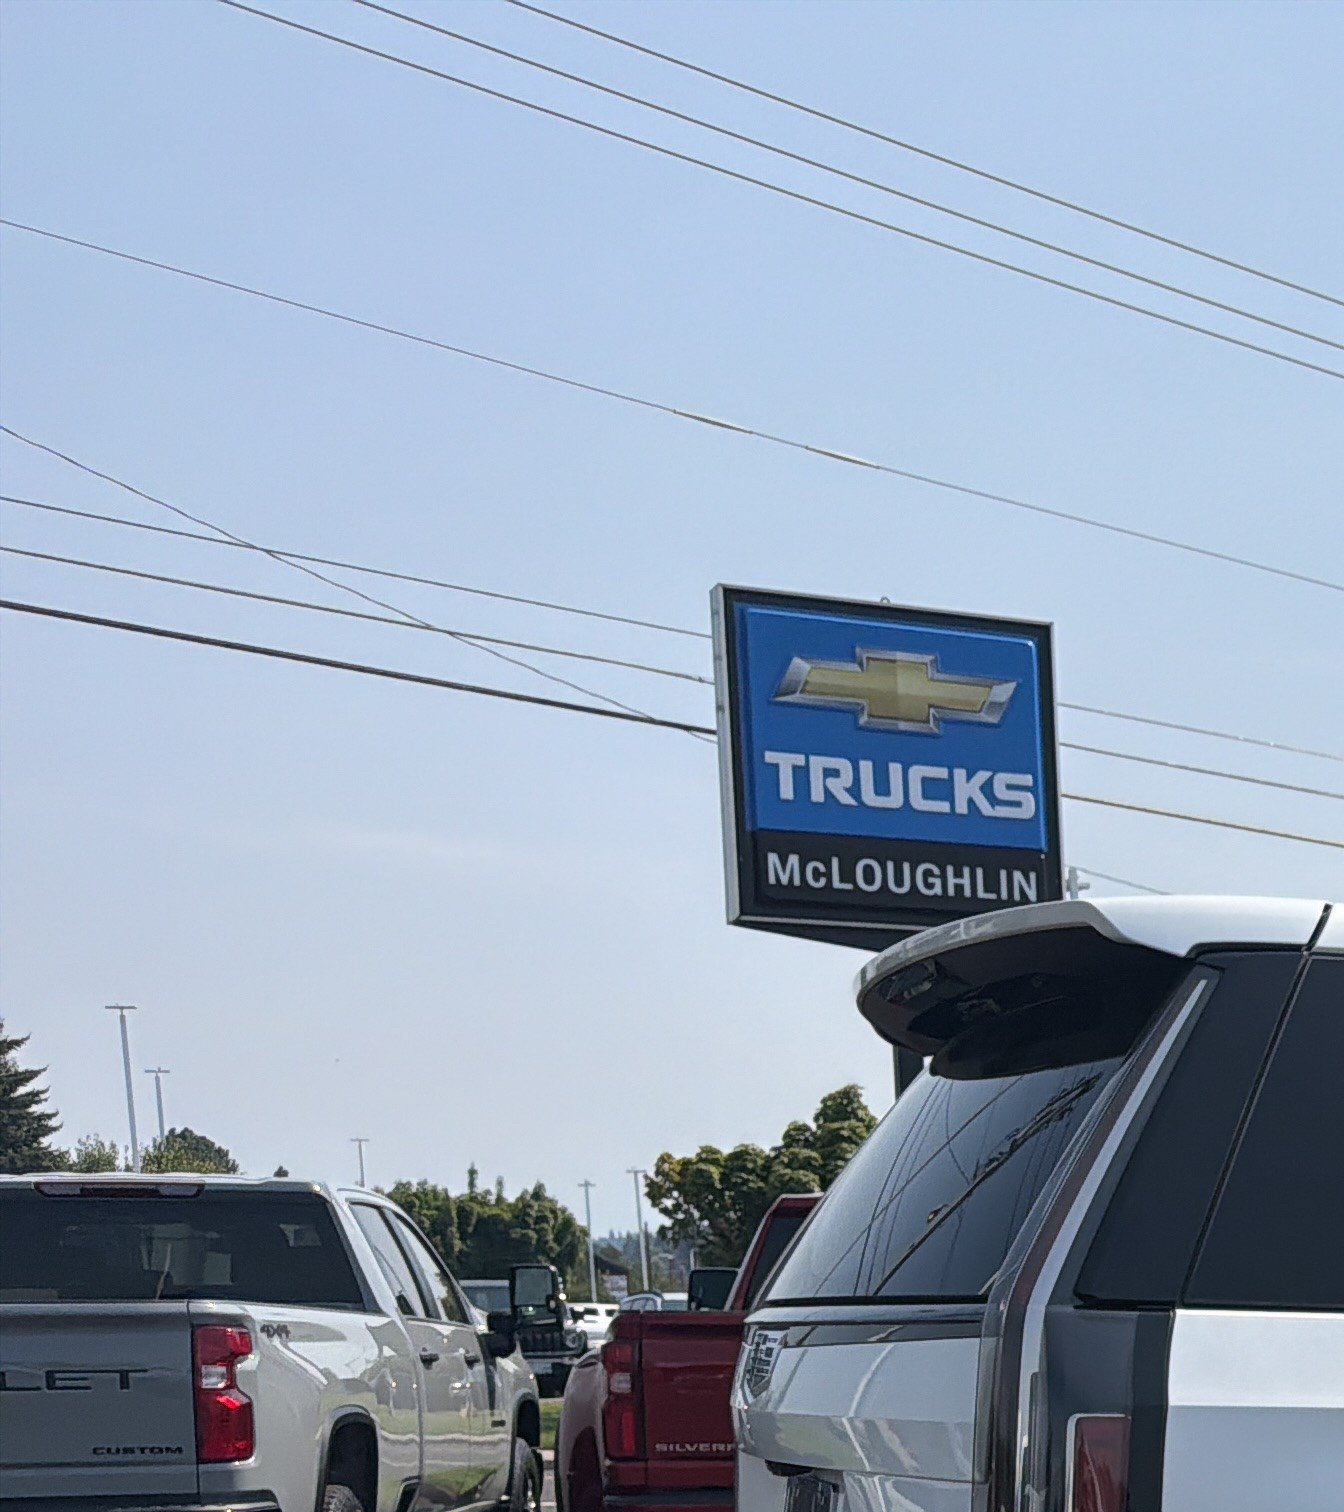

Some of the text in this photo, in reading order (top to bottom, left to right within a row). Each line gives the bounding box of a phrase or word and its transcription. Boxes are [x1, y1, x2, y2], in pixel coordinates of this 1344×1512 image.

[764, 751, 1036, 820] TRUCKS
[767, 852, 1037, 902] McLOUGHLIN
[92, 1446, 183, 1456] CUSTOM
